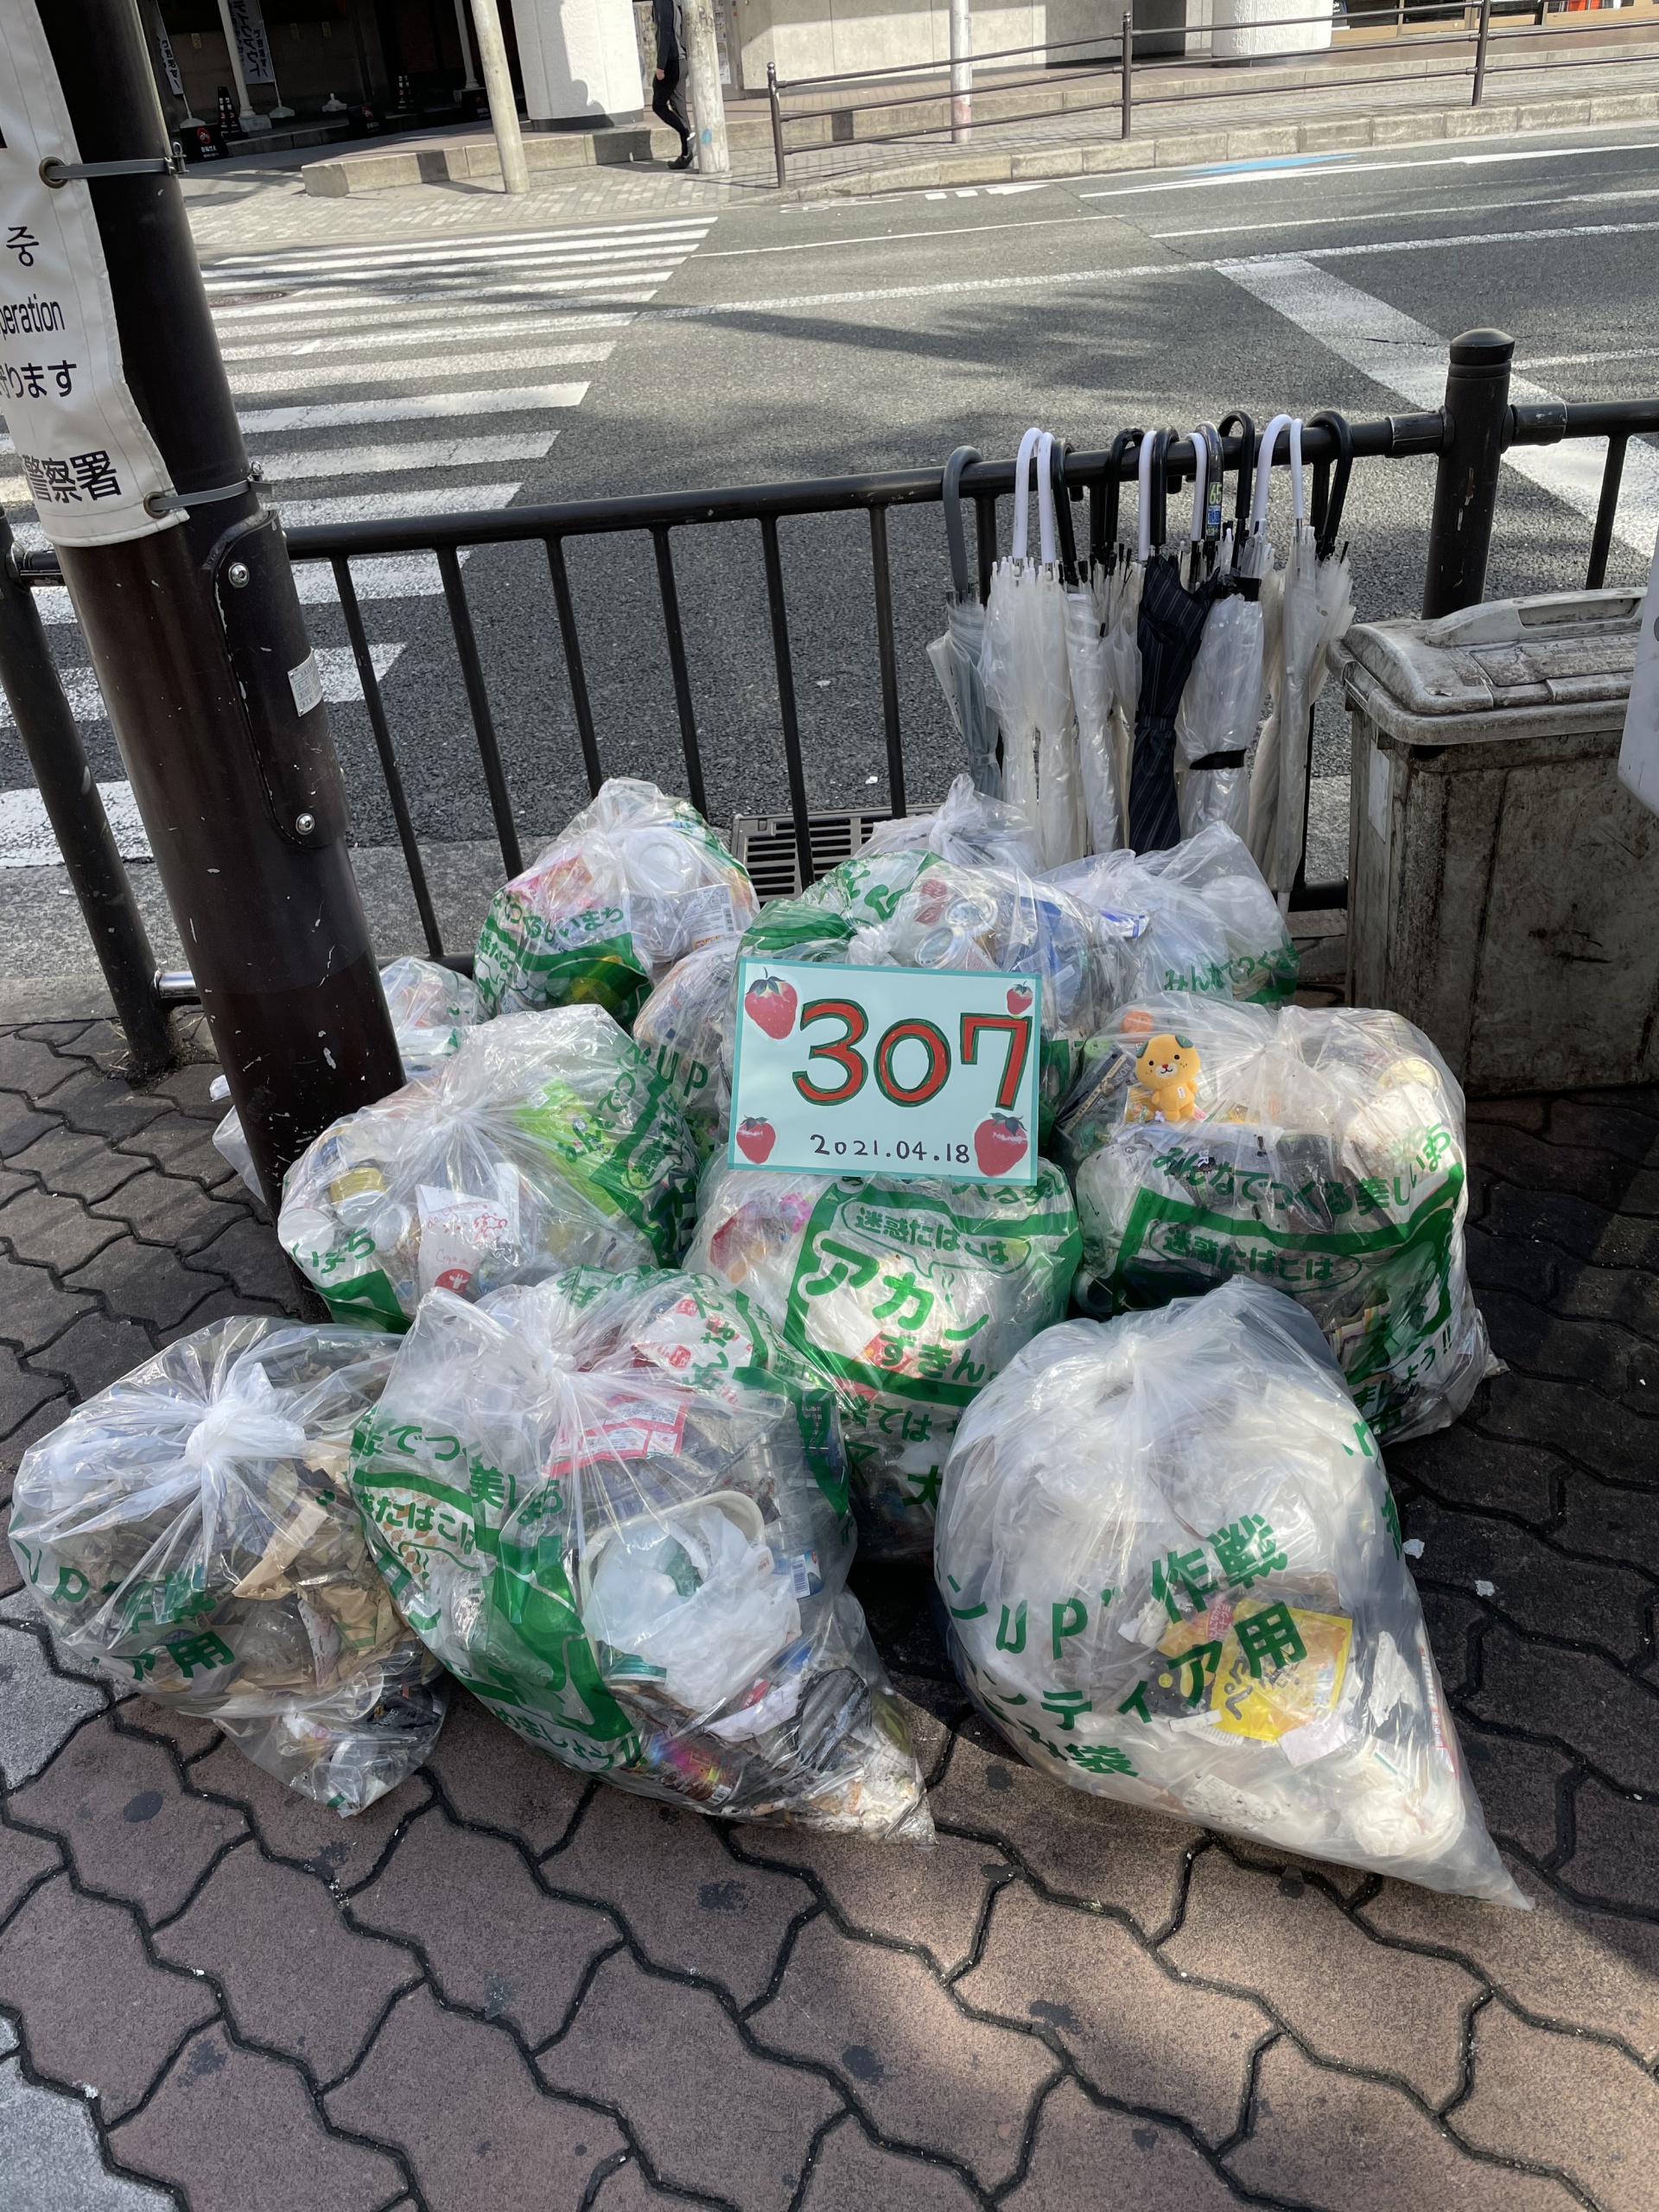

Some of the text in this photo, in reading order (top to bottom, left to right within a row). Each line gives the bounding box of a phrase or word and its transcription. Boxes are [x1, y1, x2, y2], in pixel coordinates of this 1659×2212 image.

[5, 226, 40, 267] 중
[22, 449, 122, 504] 警察署
[1209, 483, 1223, 505] 65
[791, 997, 1033, 1111] 307
[810, 1134, 970, 1164] 2021.04.18
[1161, 1227, 1334, 1281] 迷惑たばこは
[804, 1237, 989, 1341] アカン
